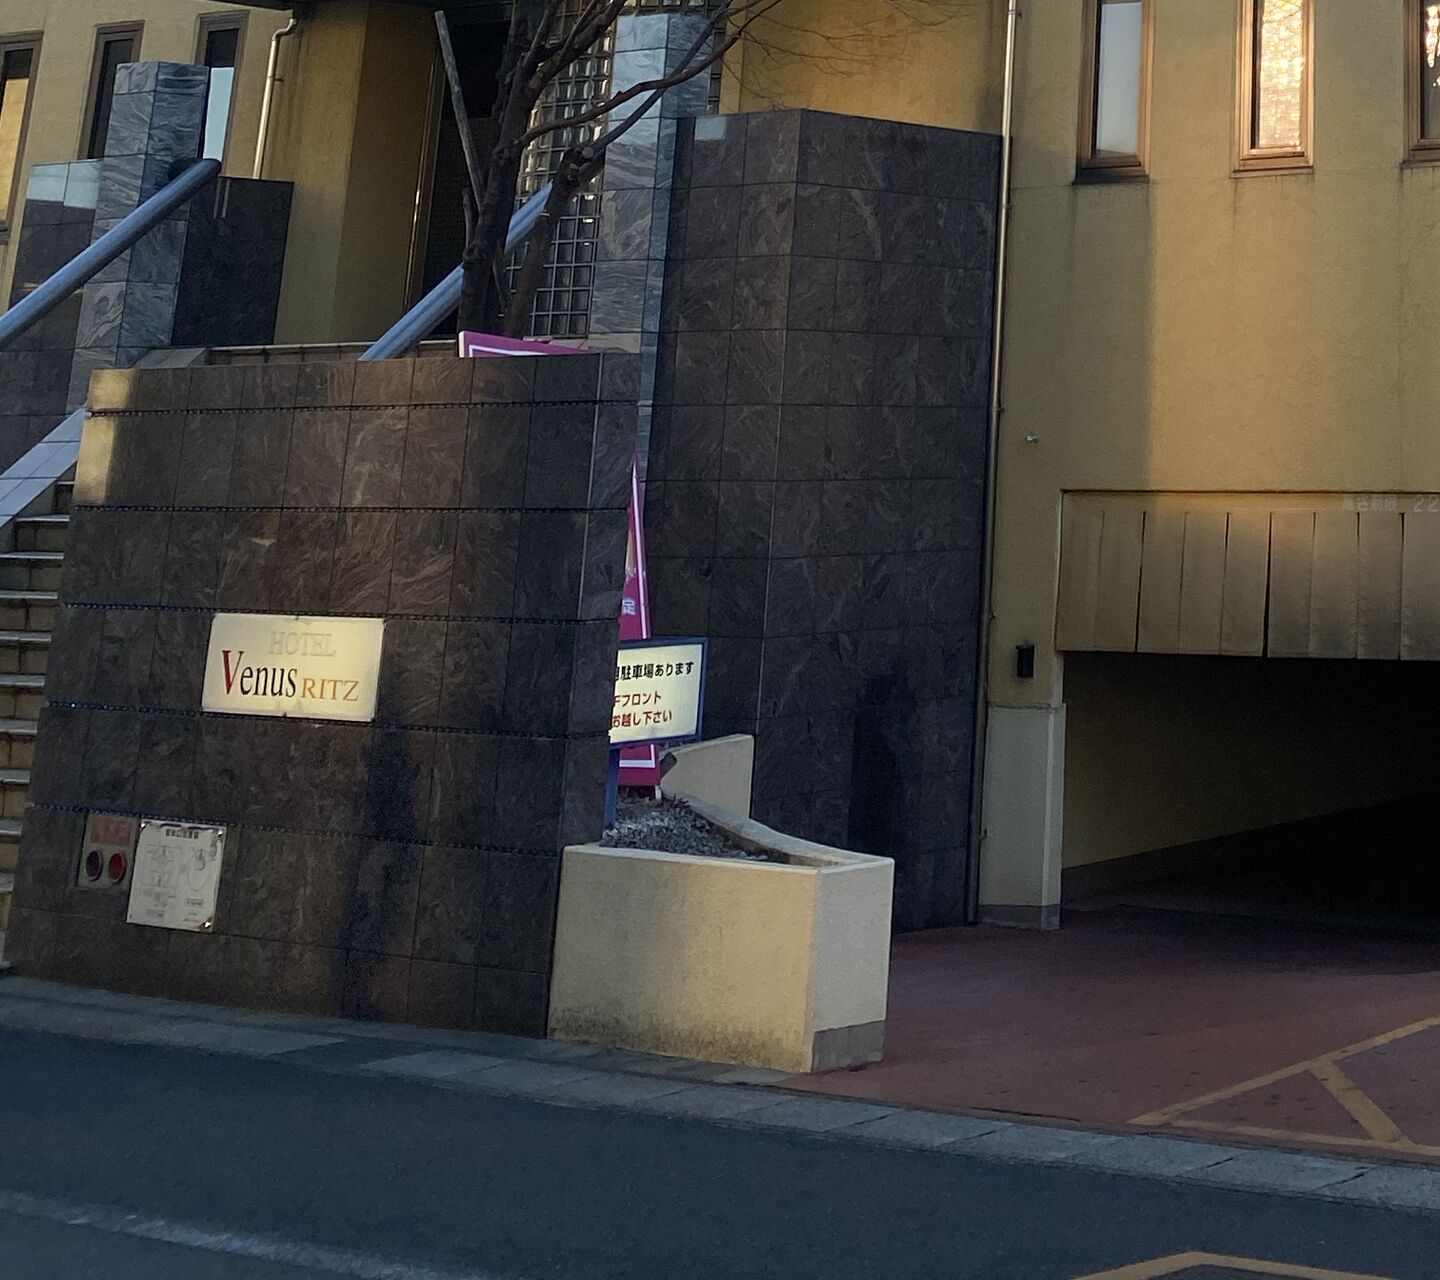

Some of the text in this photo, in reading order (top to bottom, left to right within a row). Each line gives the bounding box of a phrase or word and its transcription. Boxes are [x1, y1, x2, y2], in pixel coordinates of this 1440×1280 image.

[267, 631, 337, 657] HOTEL
[221, 649, 360, 702] Venus RITZ
